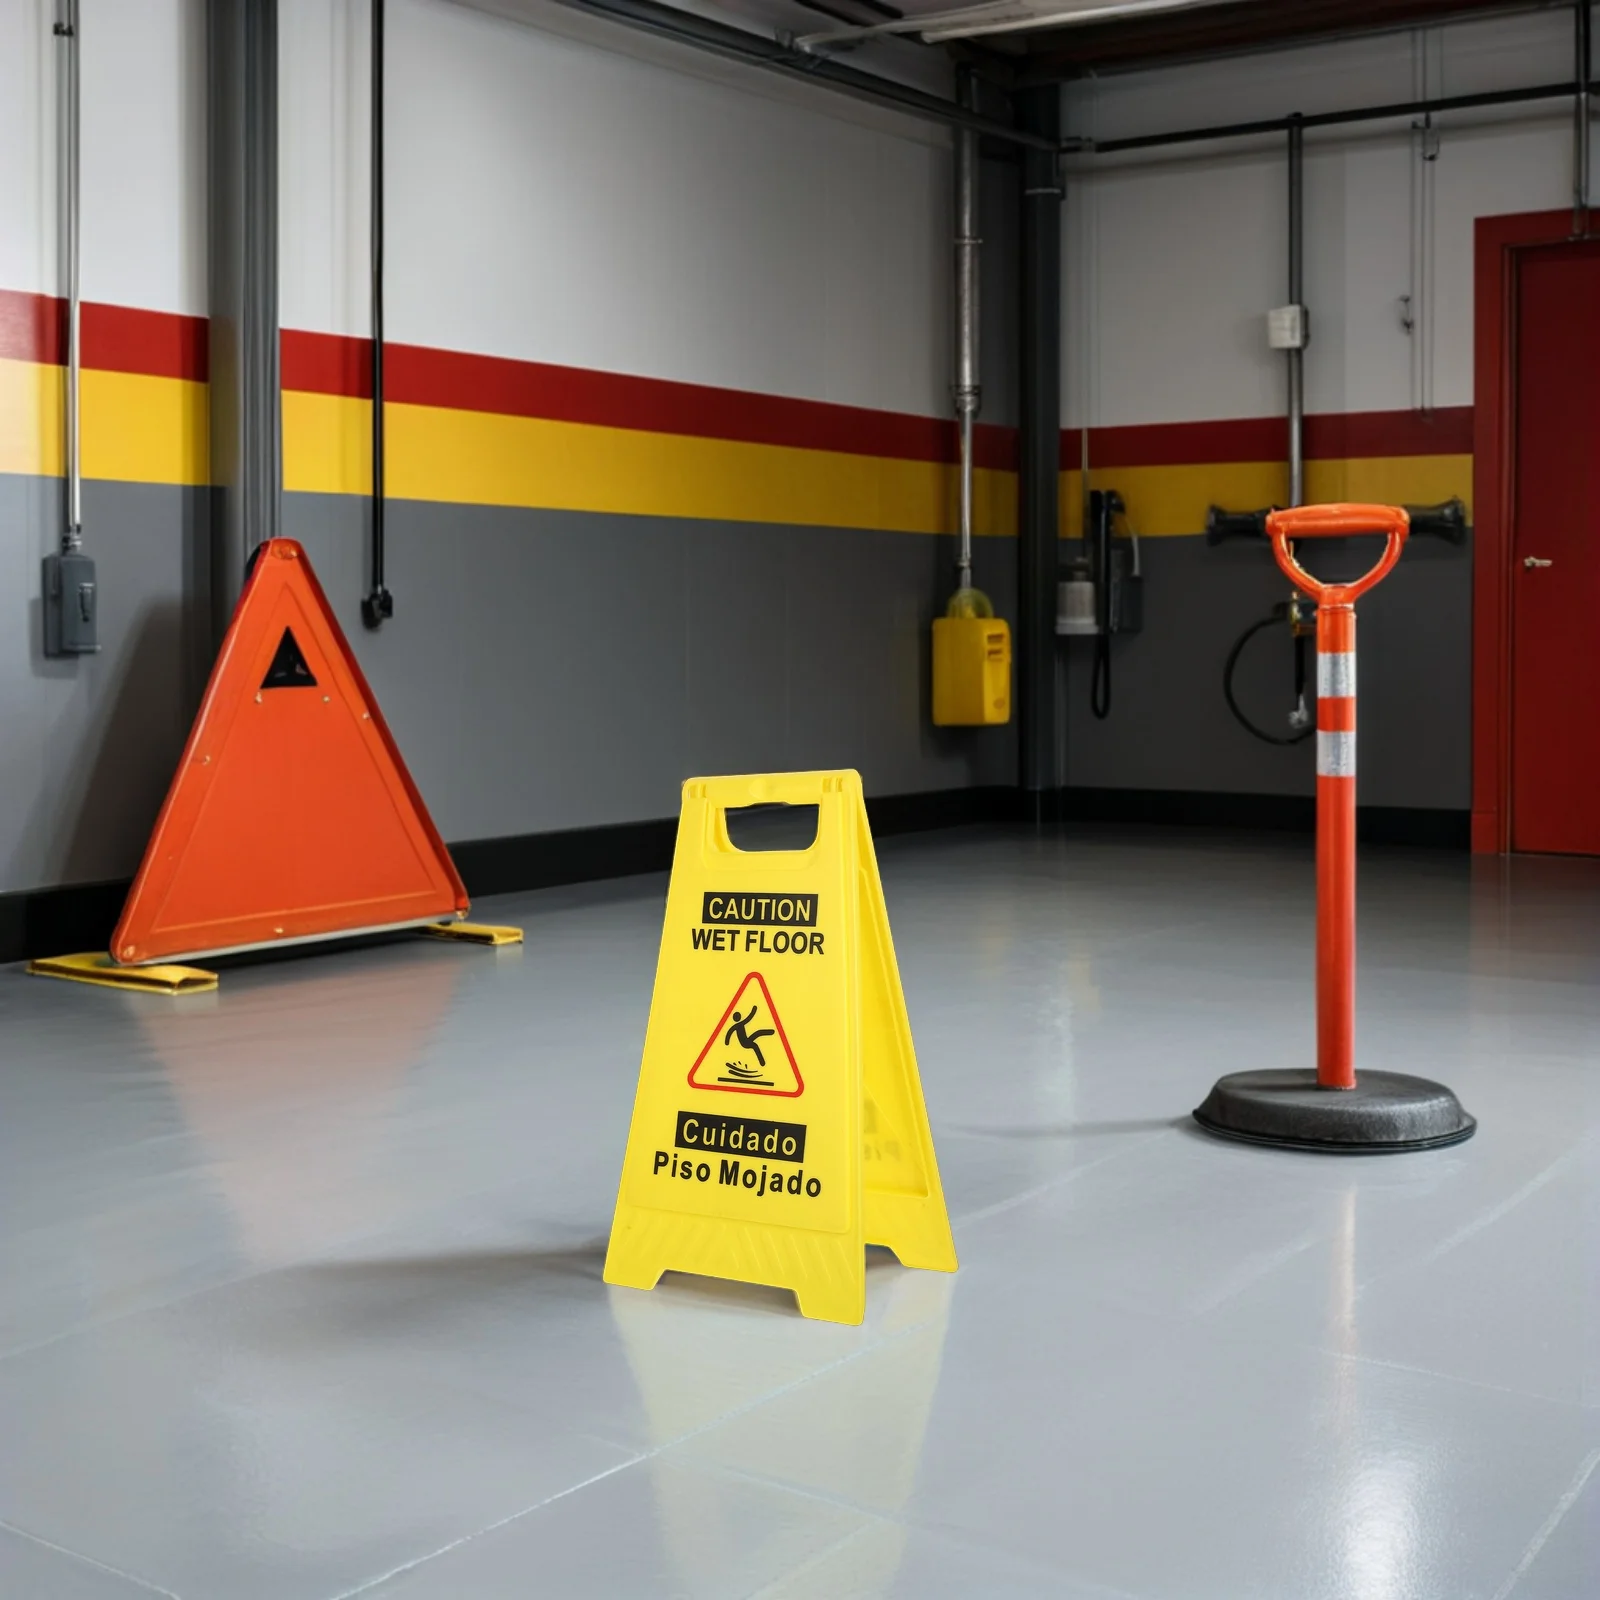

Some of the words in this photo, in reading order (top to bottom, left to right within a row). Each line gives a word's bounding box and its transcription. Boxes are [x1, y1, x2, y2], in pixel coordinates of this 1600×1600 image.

[709, 897, 811, 921] CAUTION
[691, 928, 740, 951] WET
[745, 930, 825, 955] FLOOR
[682, 1118, 797, 1156] Cuidado
[653, 1150, 711, 1182] Piso
[719, 1159, 821, 1198] Mojado
